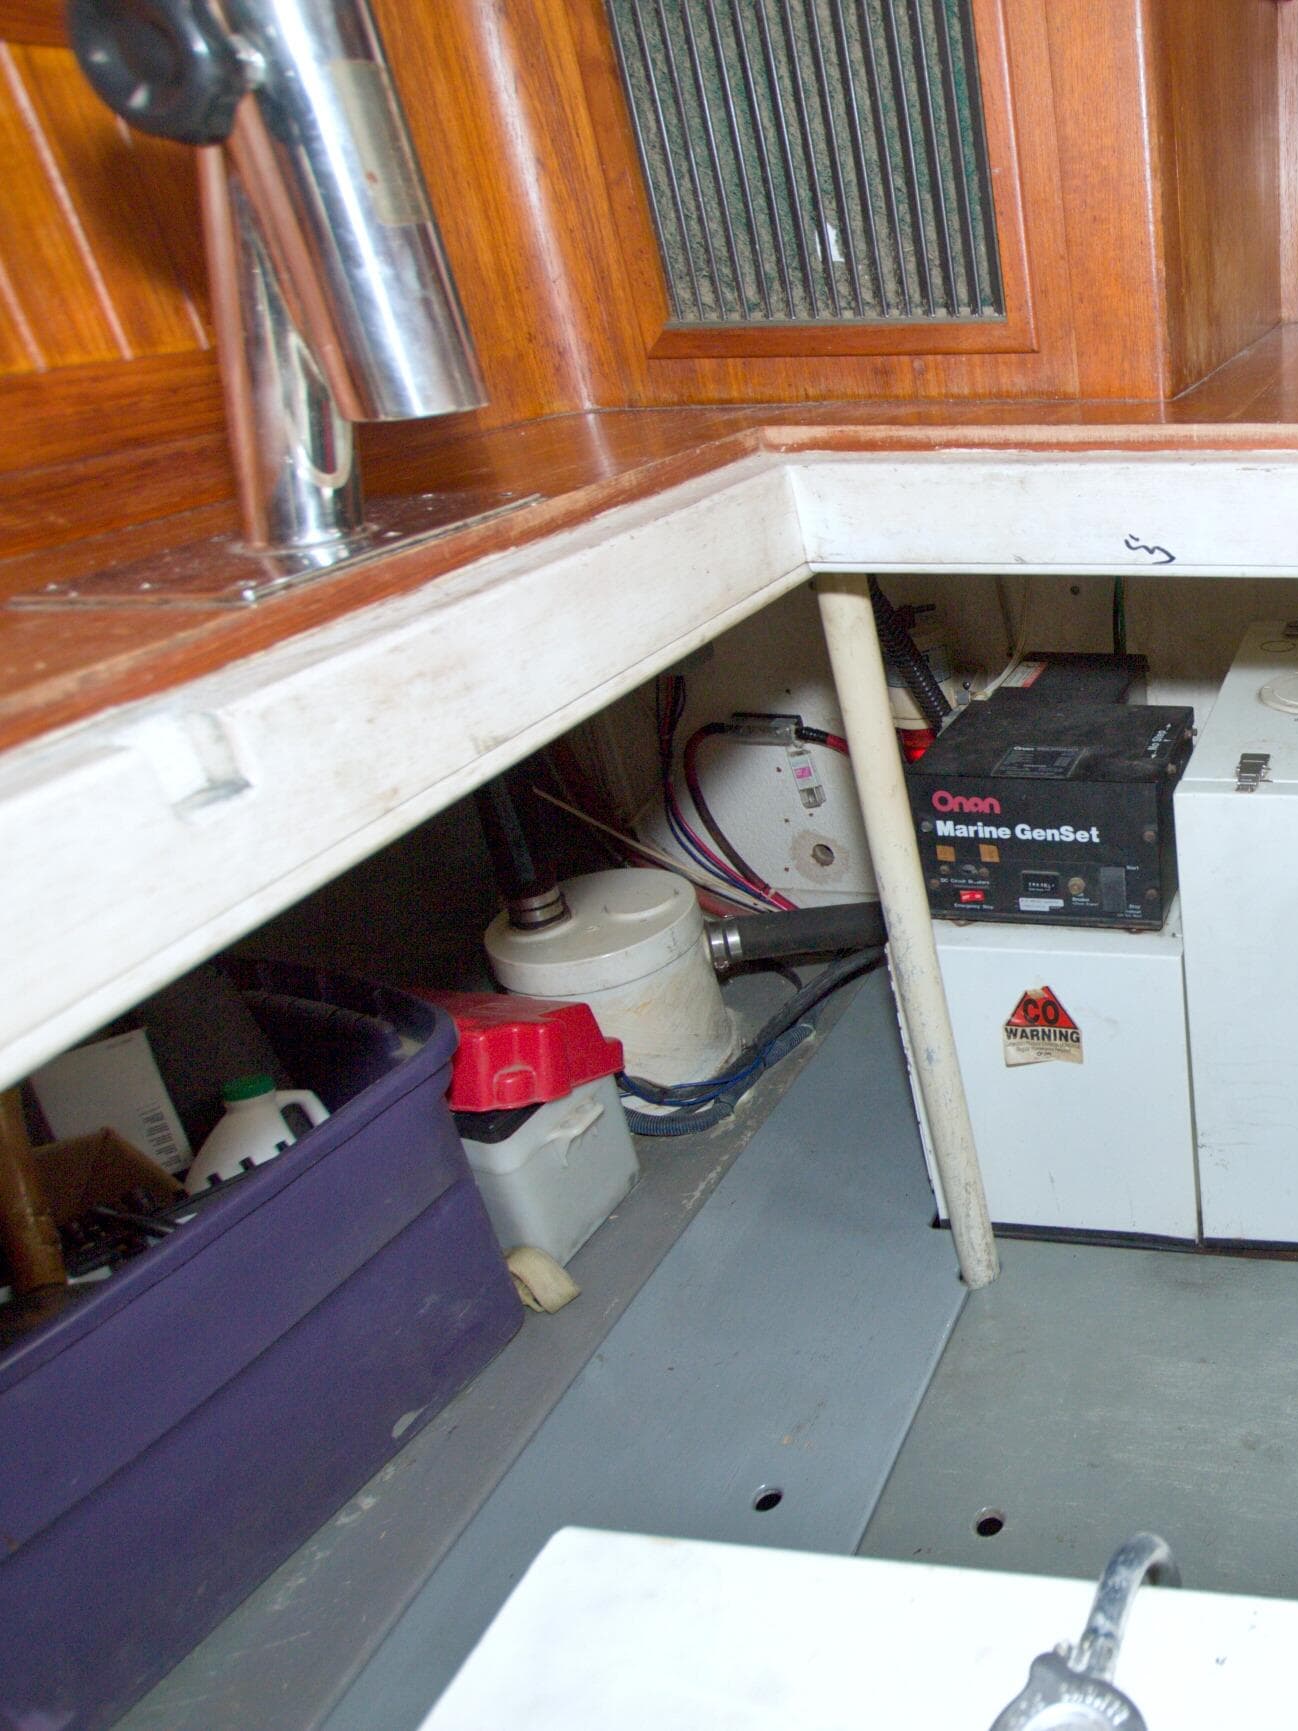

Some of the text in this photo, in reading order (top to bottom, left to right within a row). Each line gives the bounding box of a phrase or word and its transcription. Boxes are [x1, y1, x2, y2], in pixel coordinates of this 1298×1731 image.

[931, 790, 1001, 814] Onan
[935, 820, 1100, 843] Marine GenSet
[1023, 998, 1059, 1025] CO
[1004, 1027, 1080, 1043] WARNING
